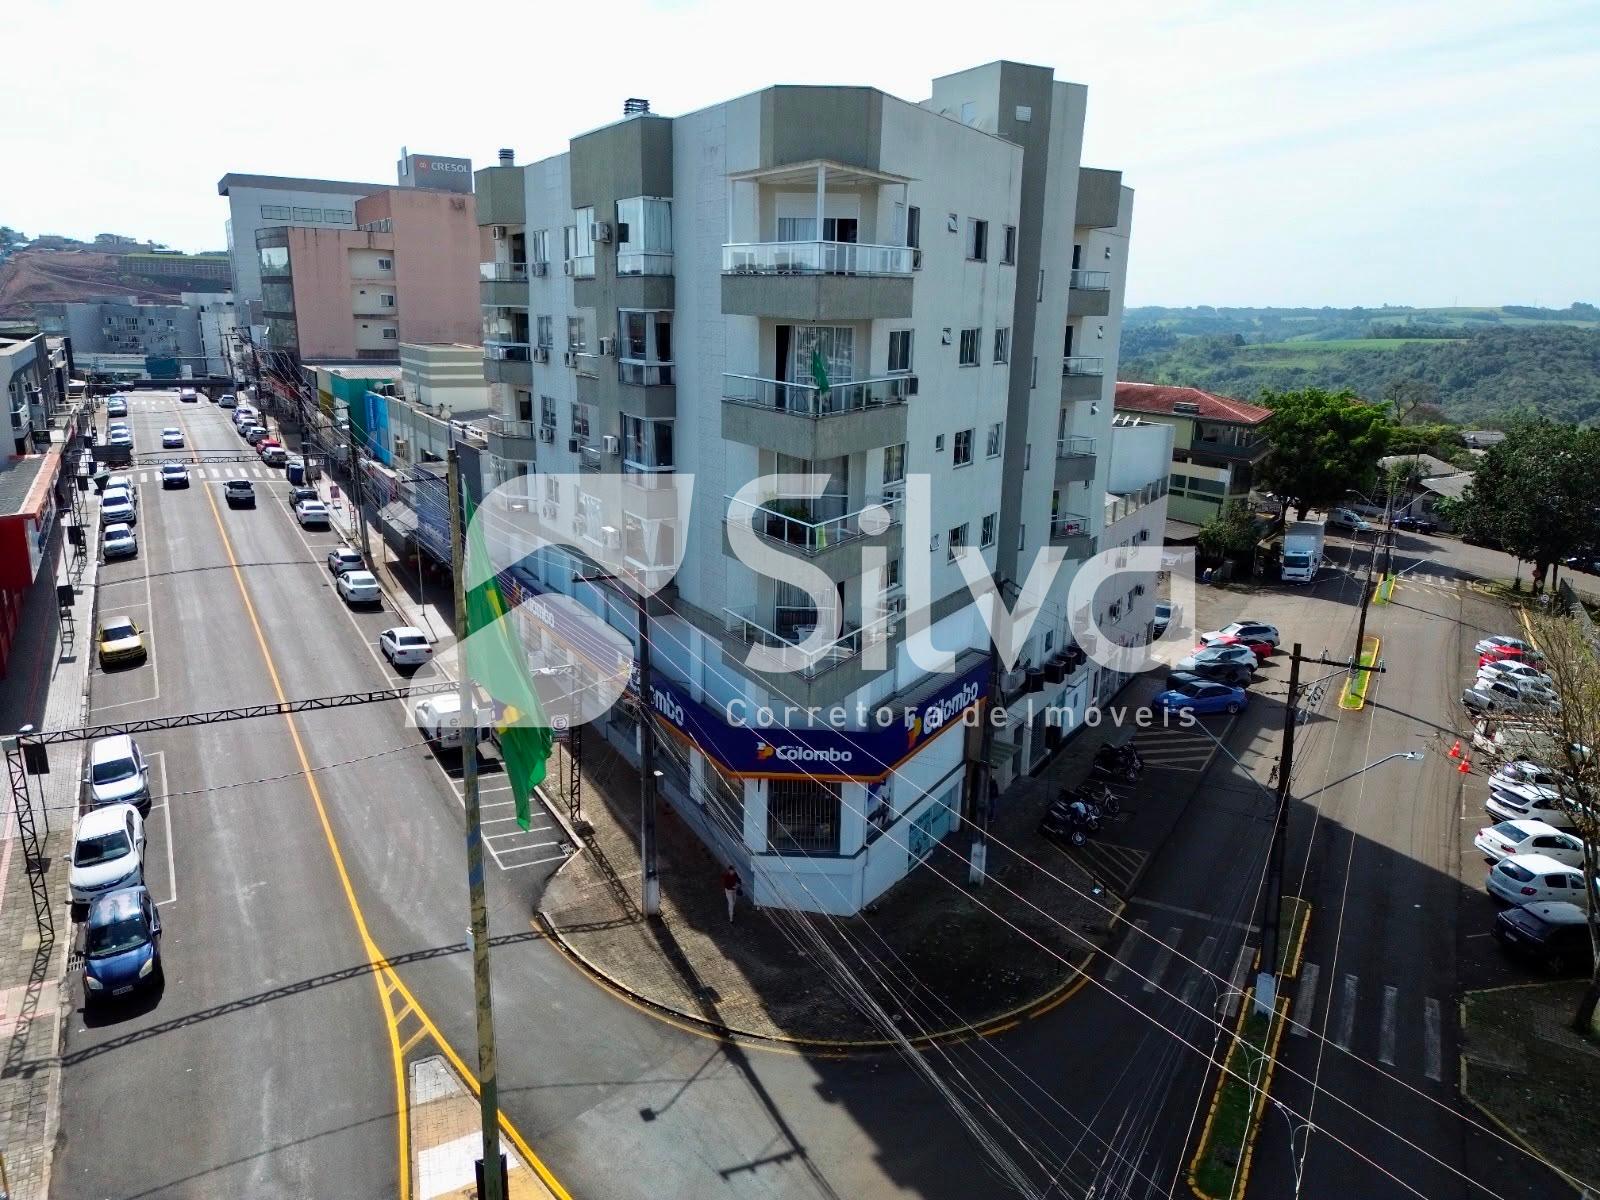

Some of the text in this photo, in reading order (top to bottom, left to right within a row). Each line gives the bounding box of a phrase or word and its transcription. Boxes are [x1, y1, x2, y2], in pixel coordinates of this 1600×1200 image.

[431, 162, 470, 173] CRESOL
[924, 681, 979, 735] Colombo
[776, 742, 852, 762] Colombo
